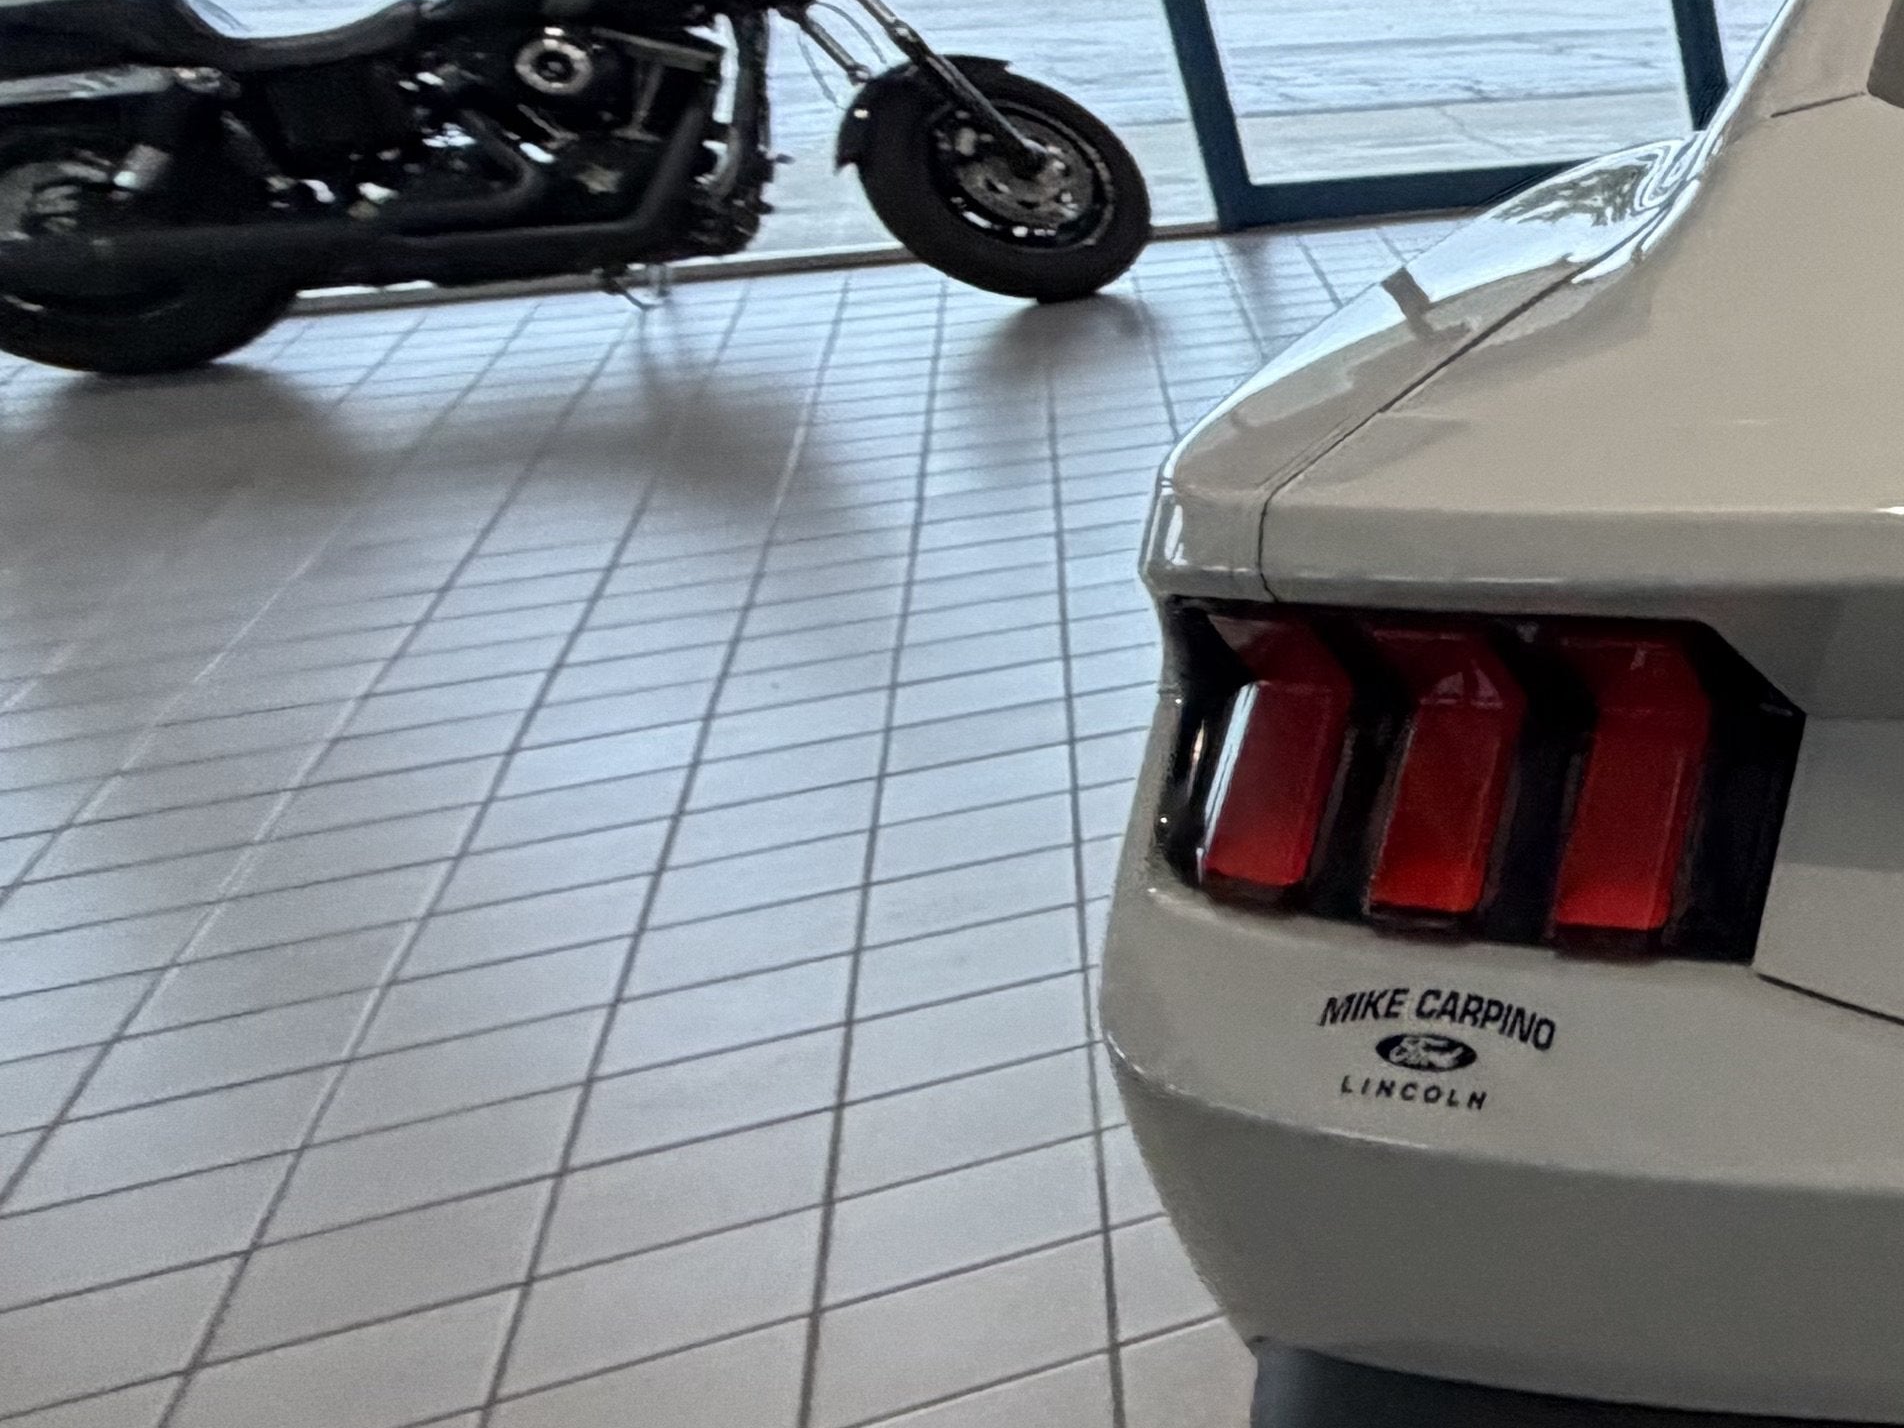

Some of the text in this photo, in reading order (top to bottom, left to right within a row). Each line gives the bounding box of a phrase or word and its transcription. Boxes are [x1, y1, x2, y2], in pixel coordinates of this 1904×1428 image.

[1317, 988, 1556, 1051] MIKE CARPINO
[1340, 1075, 1487, 1110] LINCOLN
